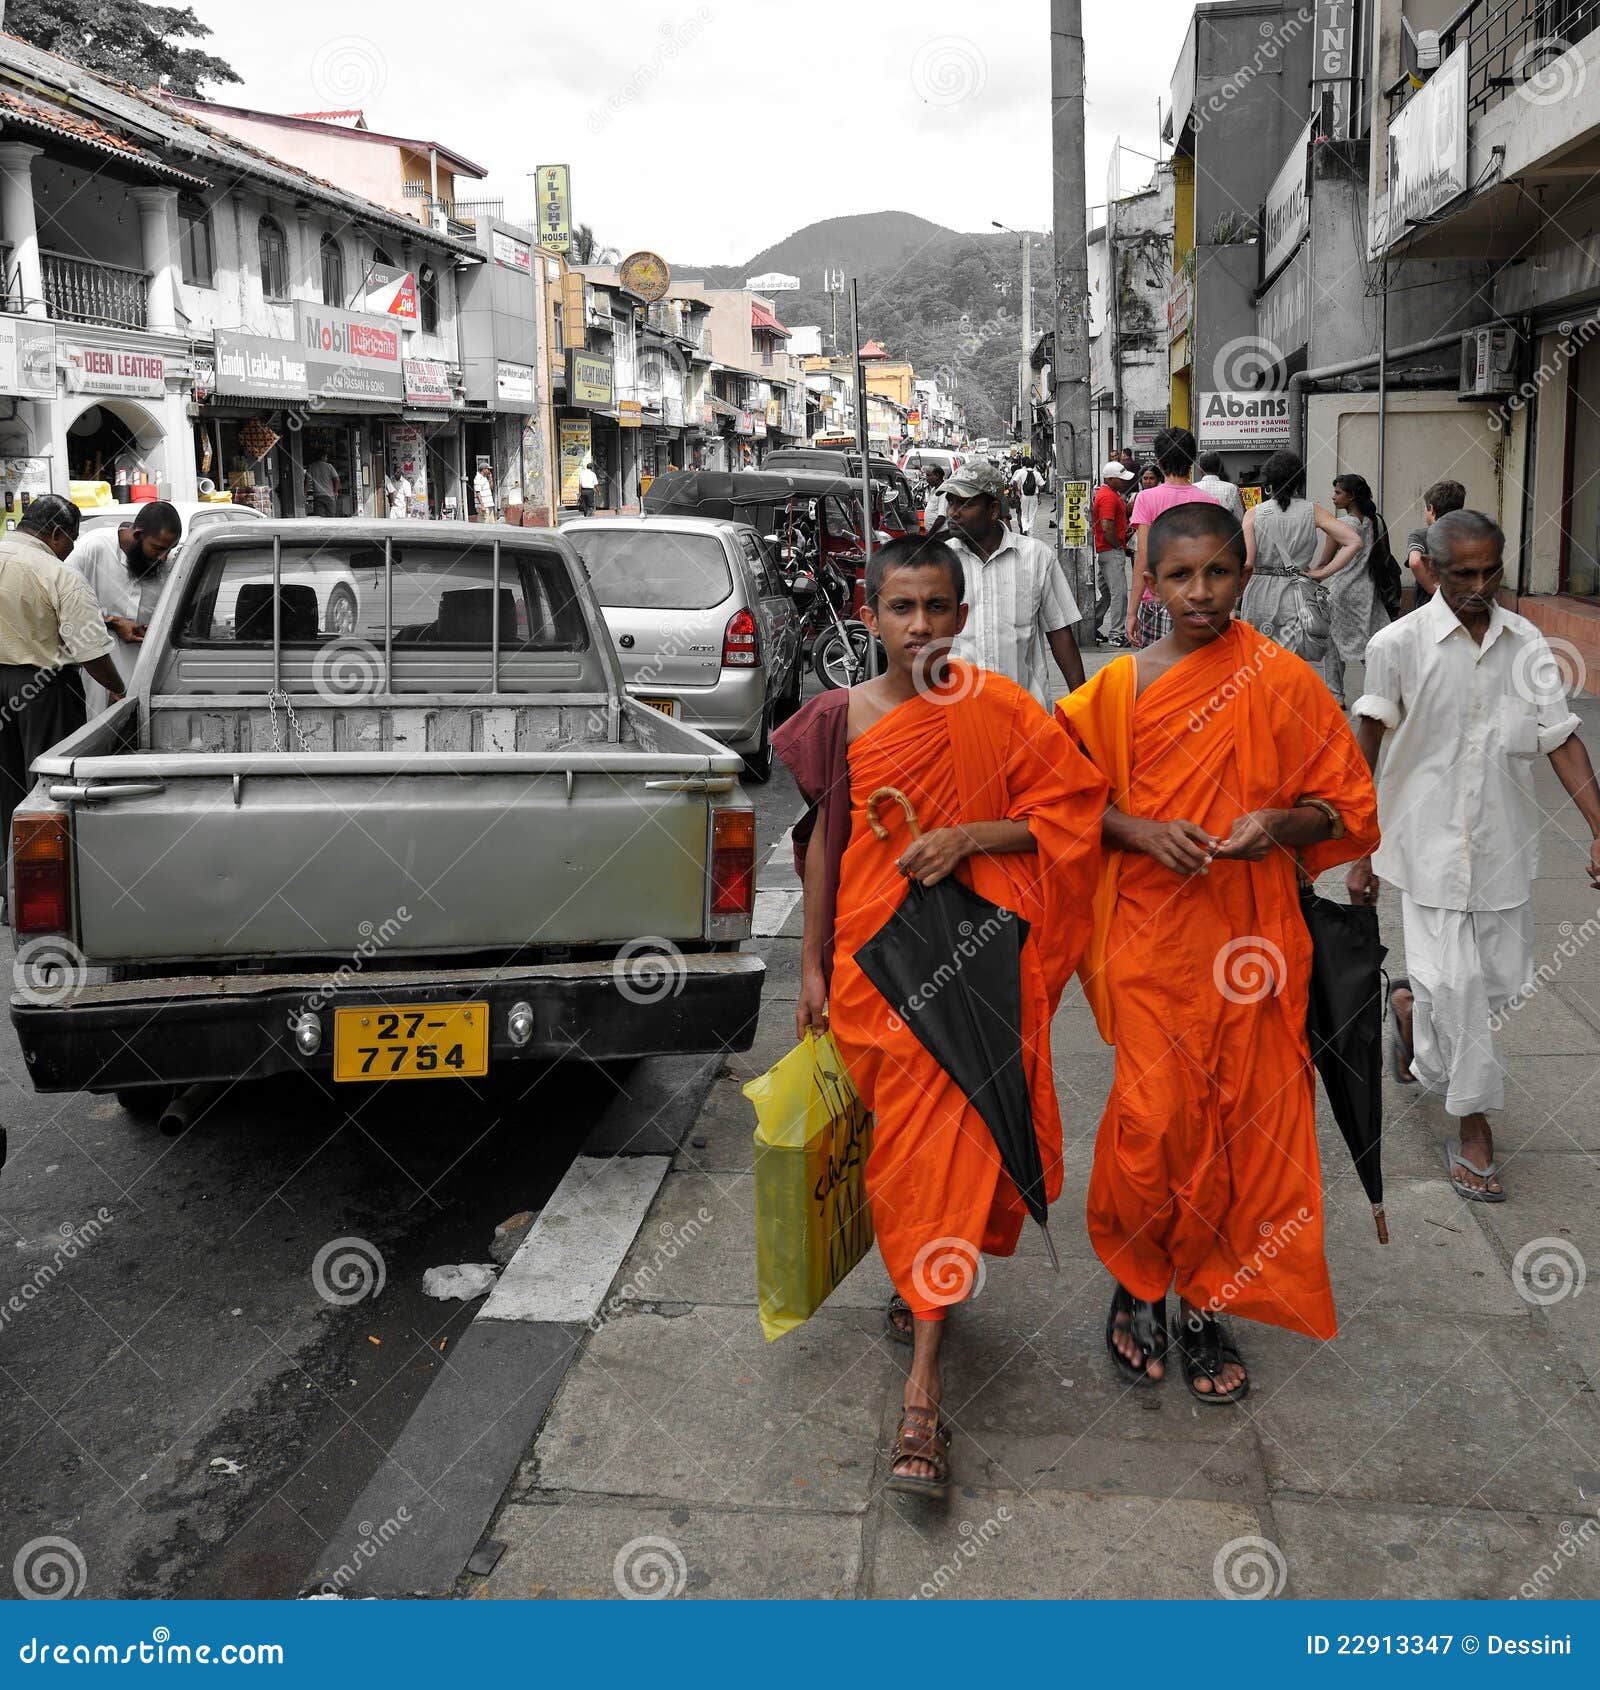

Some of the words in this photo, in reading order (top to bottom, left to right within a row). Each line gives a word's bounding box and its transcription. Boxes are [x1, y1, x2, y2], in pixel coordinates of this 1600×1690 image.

[1321, 0, 1346, 74] ING
[547, 182, 560, 232] LIGHT
[542, 233, 568, 242] HOUSE
[401, 298, 414, 312] Oils
[306, 316, 350, 354] Mobil
[352, 331, 395, 355] Lubricants
[84, 351, 113, 375] DEEN
[118, 355, 163, 379] LEATHER
[216, 346, 246, 382] Kandy
[246, 350, 280, 380] Leather
[281, 355, 306, 382] House
[582, 364, 595, 384] LIGHT
[596, 367, 610, 386] HOUSE
[370, 380, 385, 393] SONS
[1205, 394, 1286, 418] Abans
[1069, 498, 1081, 529] UPUL
[689, 644, 715, 652] ALTO
[377, 1013, 447, 1040] 27-
[357, 1043, 465, 1072] 7754
